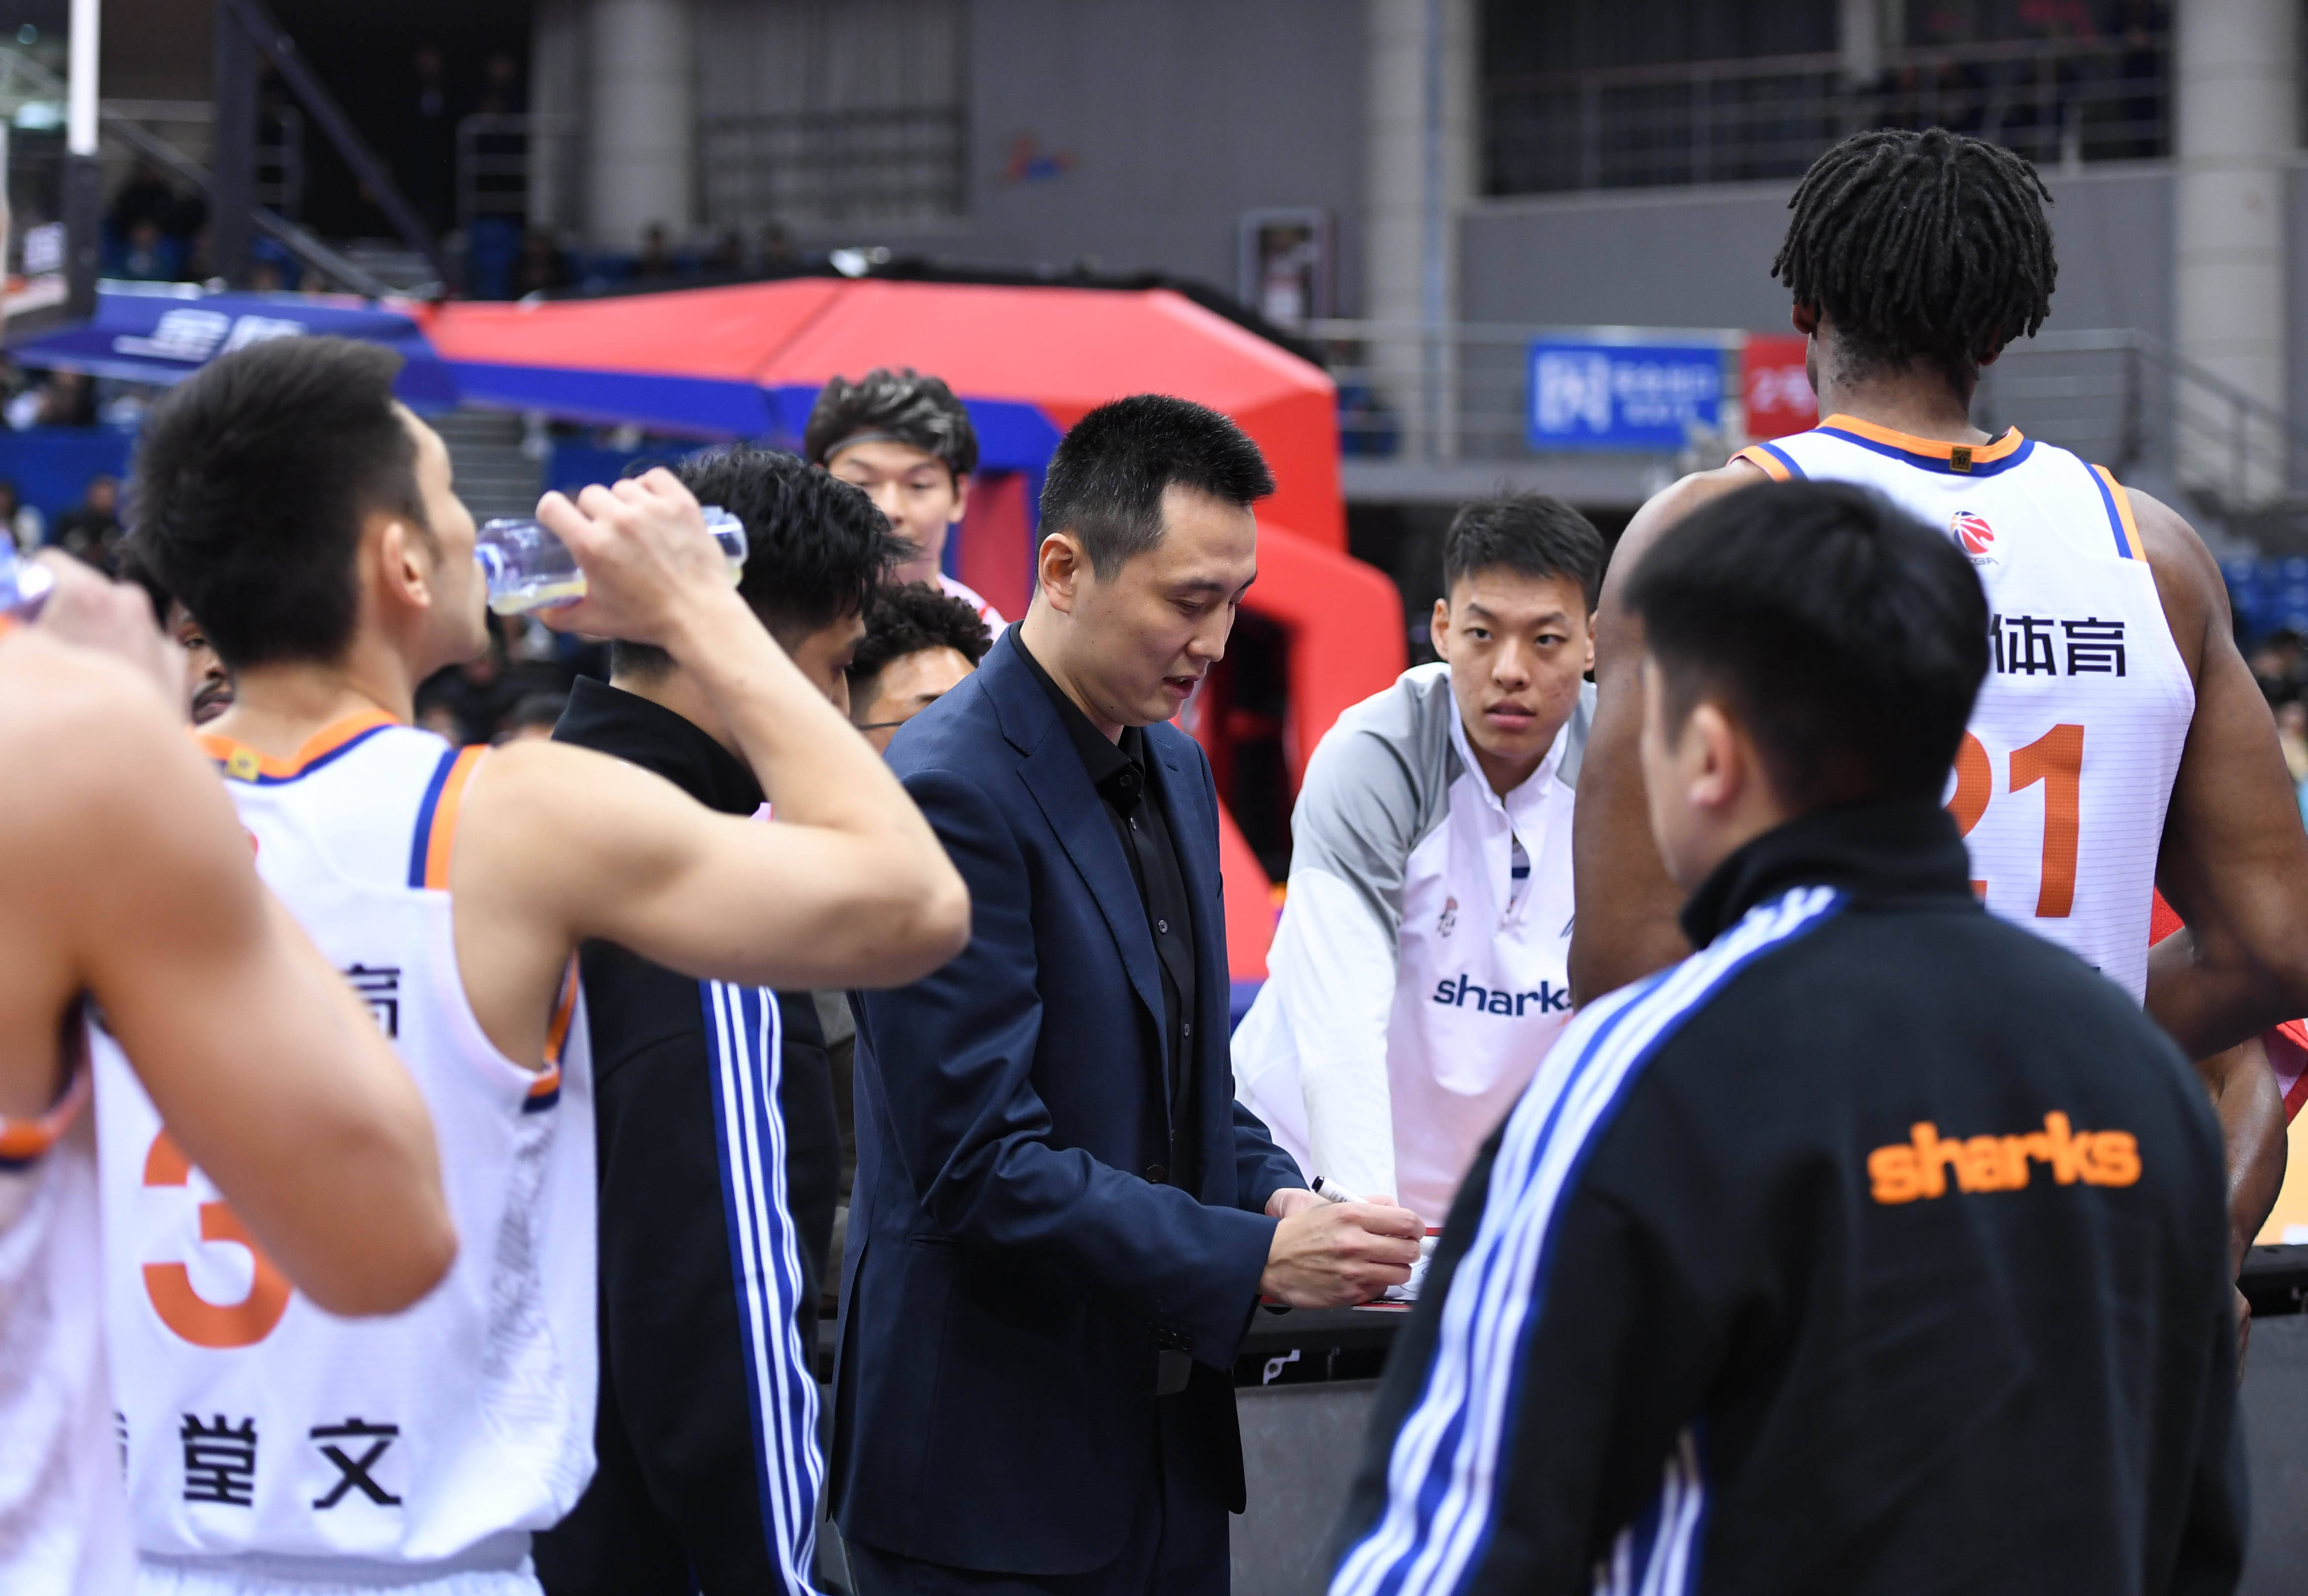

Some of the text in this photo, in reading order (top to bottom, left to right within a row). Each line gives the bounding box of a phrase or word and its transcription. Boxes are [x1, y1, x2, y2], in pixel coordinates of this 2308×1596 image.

[1990, 614, 2127, 677] 体育
[1432, 973, 1573, 1016] shark
[1867, 1109, 2143, 1205] sharks
[143, 1129, 292, 1348] 3
[114, 1410, 402, 1509] 堂文
